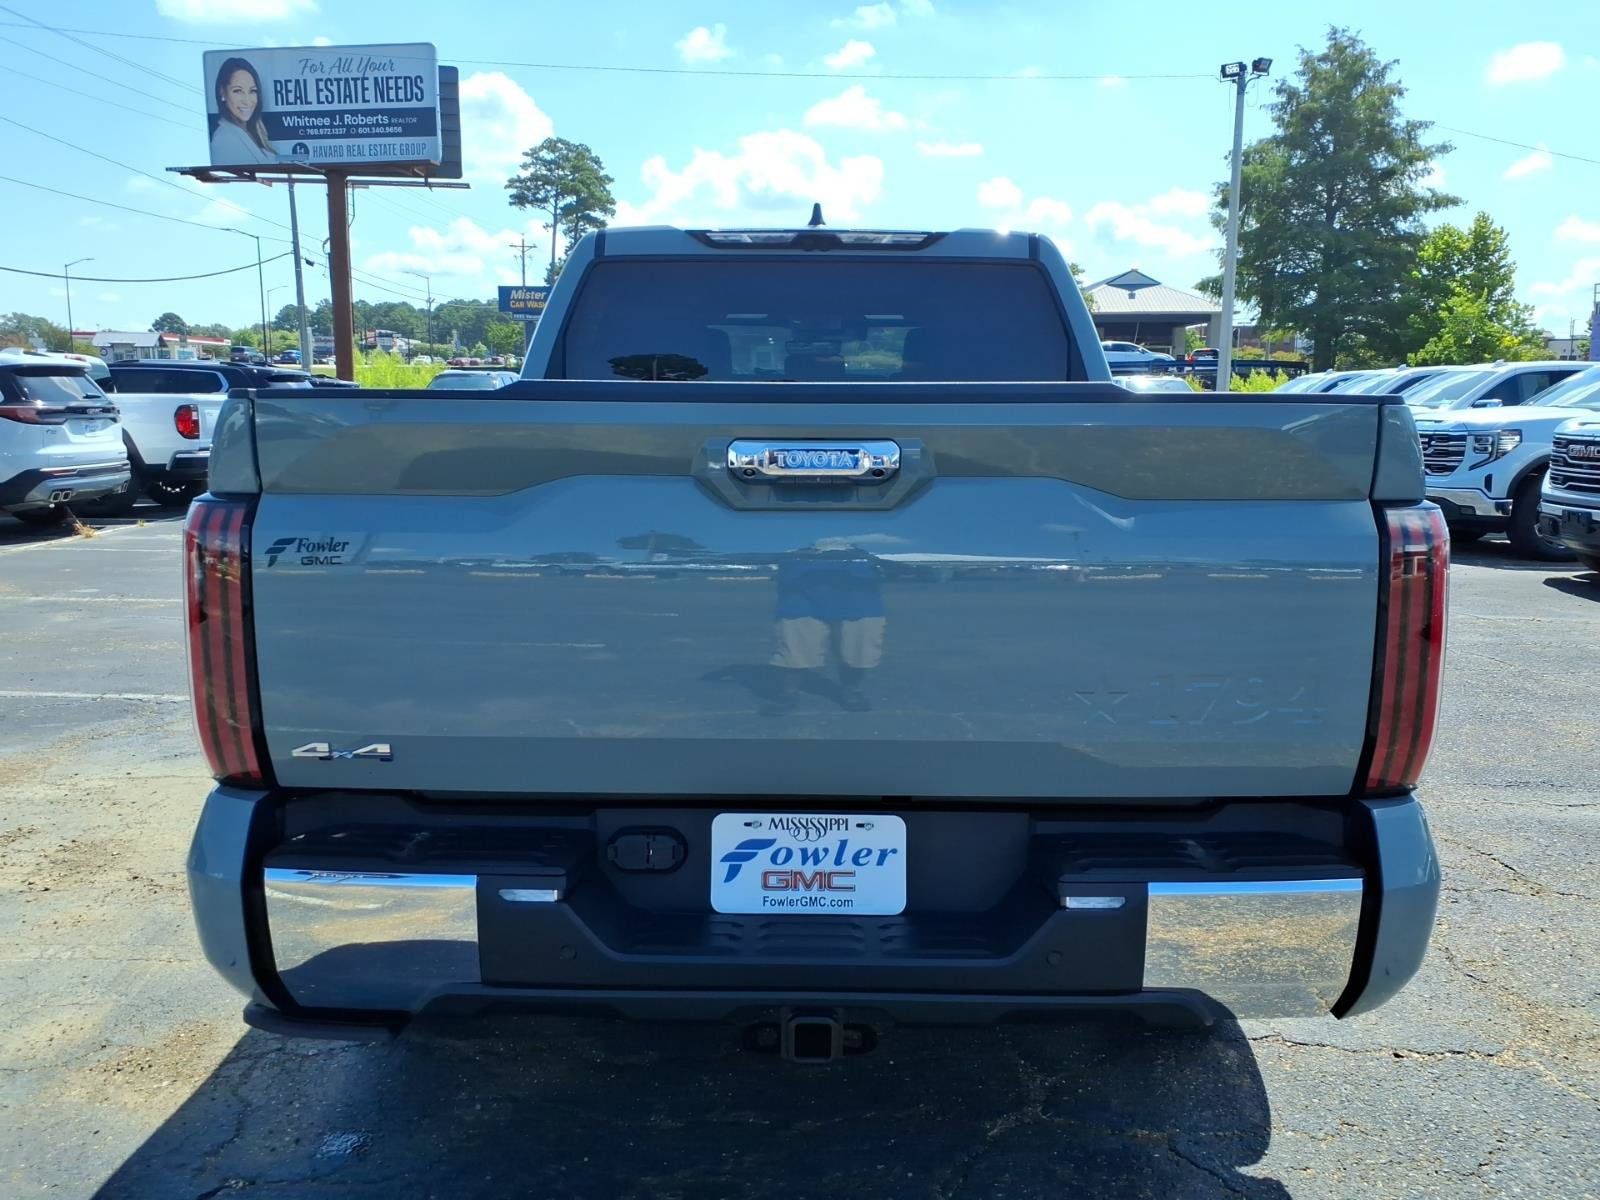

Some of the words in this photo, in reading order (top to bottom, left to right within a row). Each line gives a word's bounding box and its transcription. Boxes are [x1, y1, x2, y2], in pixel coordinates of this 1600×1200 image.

[298, 58, 326, 76] For
[329, 56, 353, 75] All
[357, 55, 397, 77] Your
[273, 78, 313, 106] REAL
[315, 76, 370, 105] ESTATE
[373, 74, 425, 104] NEEDS
[282, 115, 331, 127] Whitnee
[333, 114, 342, 126] J.
[344, 113, 389, 125] Roberts
[312, 144, 344, 158] HAVARD
[346, 144, 367, 157] REAL
[368, 143, 397, 156] ESTATE
[399, 142, 427, 156] GROUP
[510, 287, 547, 300] Mister
[773, 450, 856, 468] TOYOTA
[295, 536, 350, 553] Fowler
[301, 555, 343, 566] GMC
[768, 816, 849, 842] MISSISSIPPI
[719, 838, 898, 883] Fowler
[760, 869, 856, 892] GMC
[762, 895, 854, 908] FowlerGMC.com
